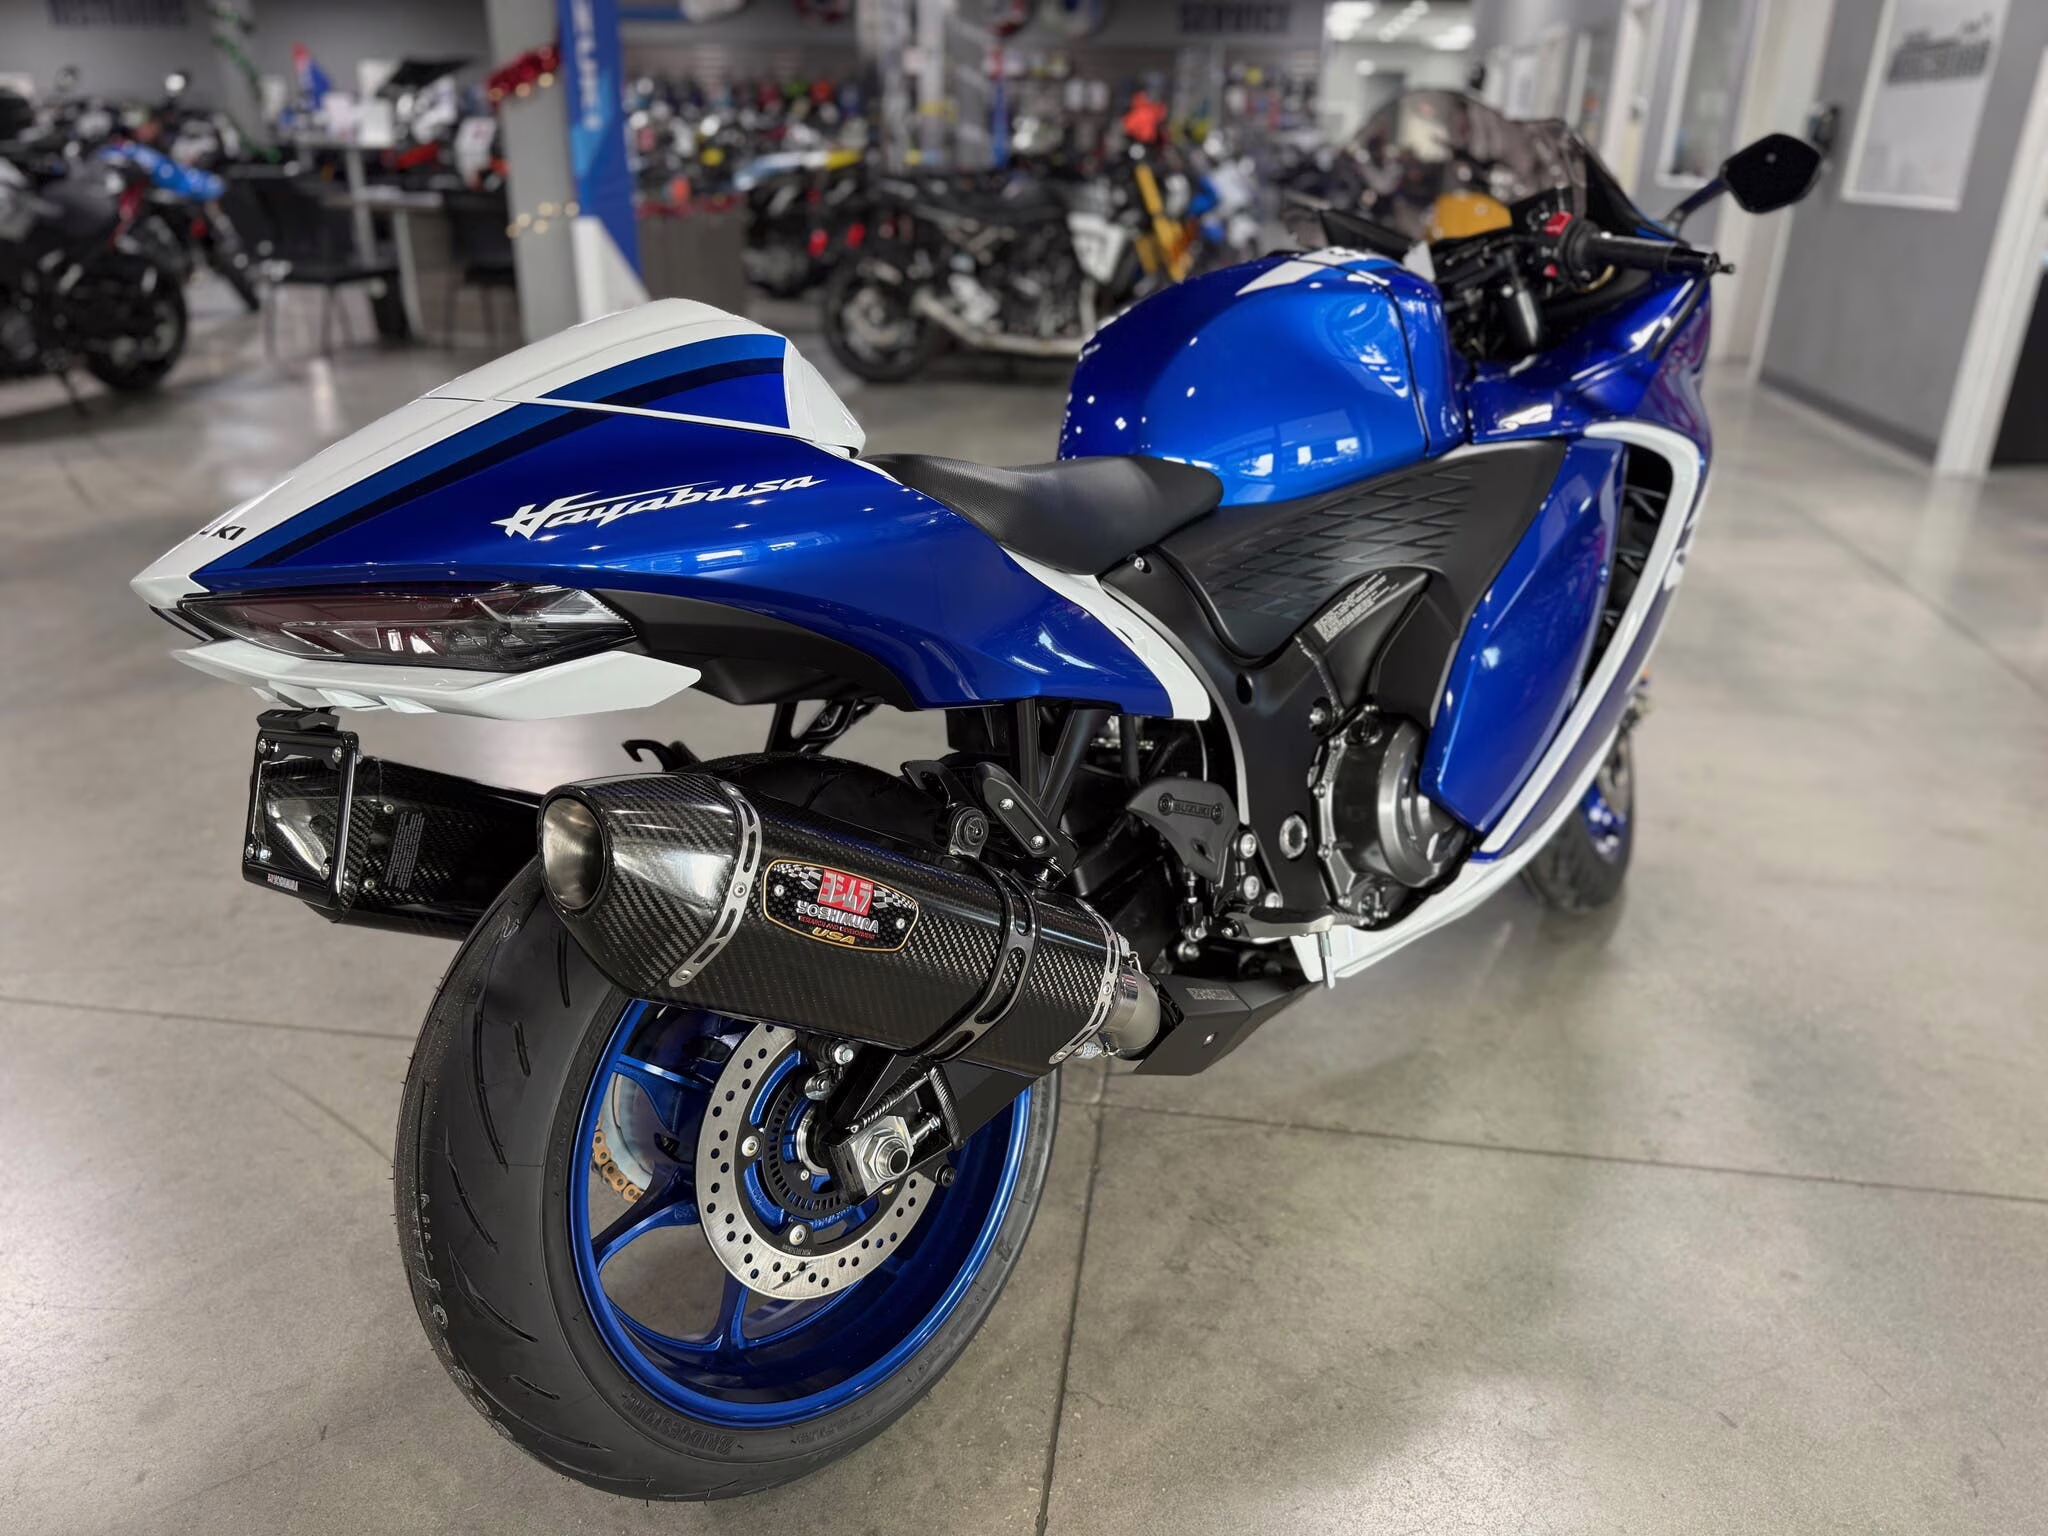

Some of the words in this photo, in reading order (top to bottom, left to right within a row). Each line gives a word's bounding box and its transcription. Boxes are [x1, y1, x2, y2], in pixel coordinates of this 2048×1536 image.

[490, 475, 829, 540] Hayabusa
[796, 900, 879, 933] YOSHIMURA
[812, 926, 856, 945] USA
